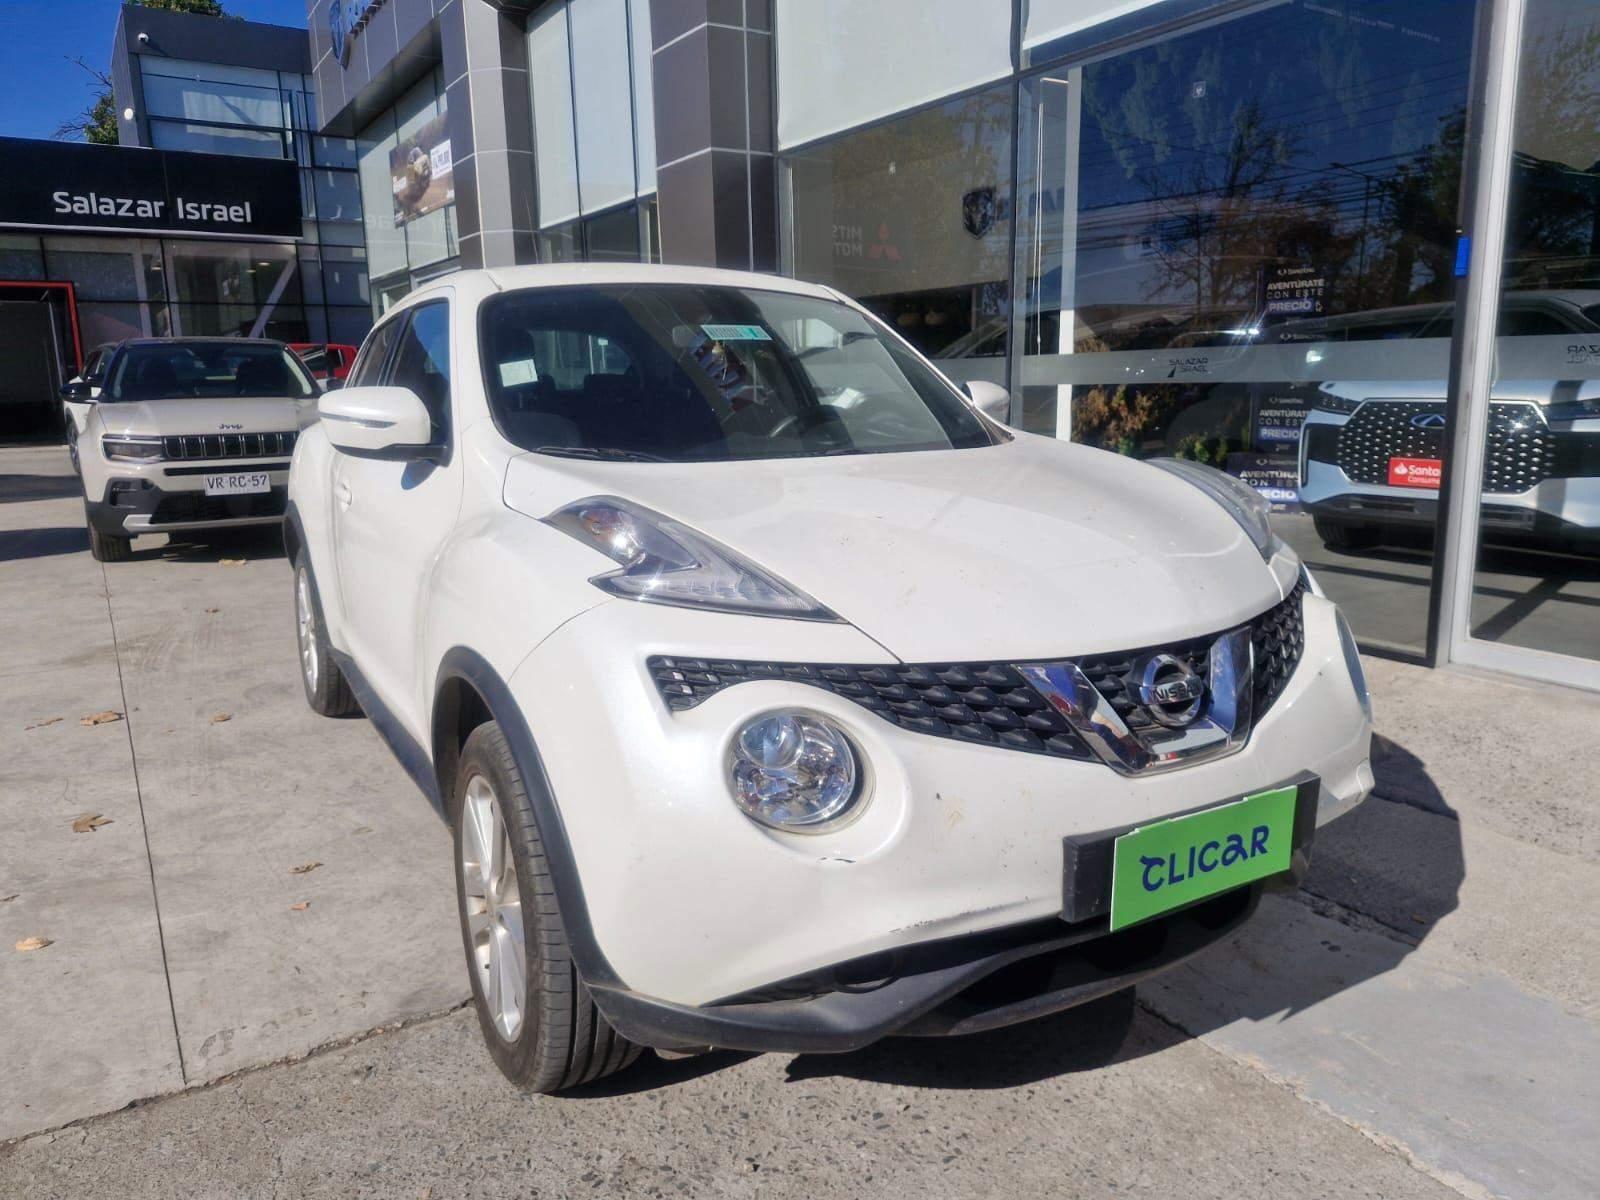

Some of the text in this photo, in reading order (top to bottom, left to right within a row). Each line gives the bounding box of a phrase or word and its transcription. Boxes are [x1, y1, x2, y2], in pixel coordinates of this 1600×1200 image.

[53, 192, 251, 223] Salazar Israel
[1266, 288, 1324, 300] CON ESTE
[1269, 300, 1312, 311] PRECIO
[1258, 418, 1281, 426] CON
[1261, 428, 1300, 439] PRECIO
[1407, 464, 1441, 477] Santa
